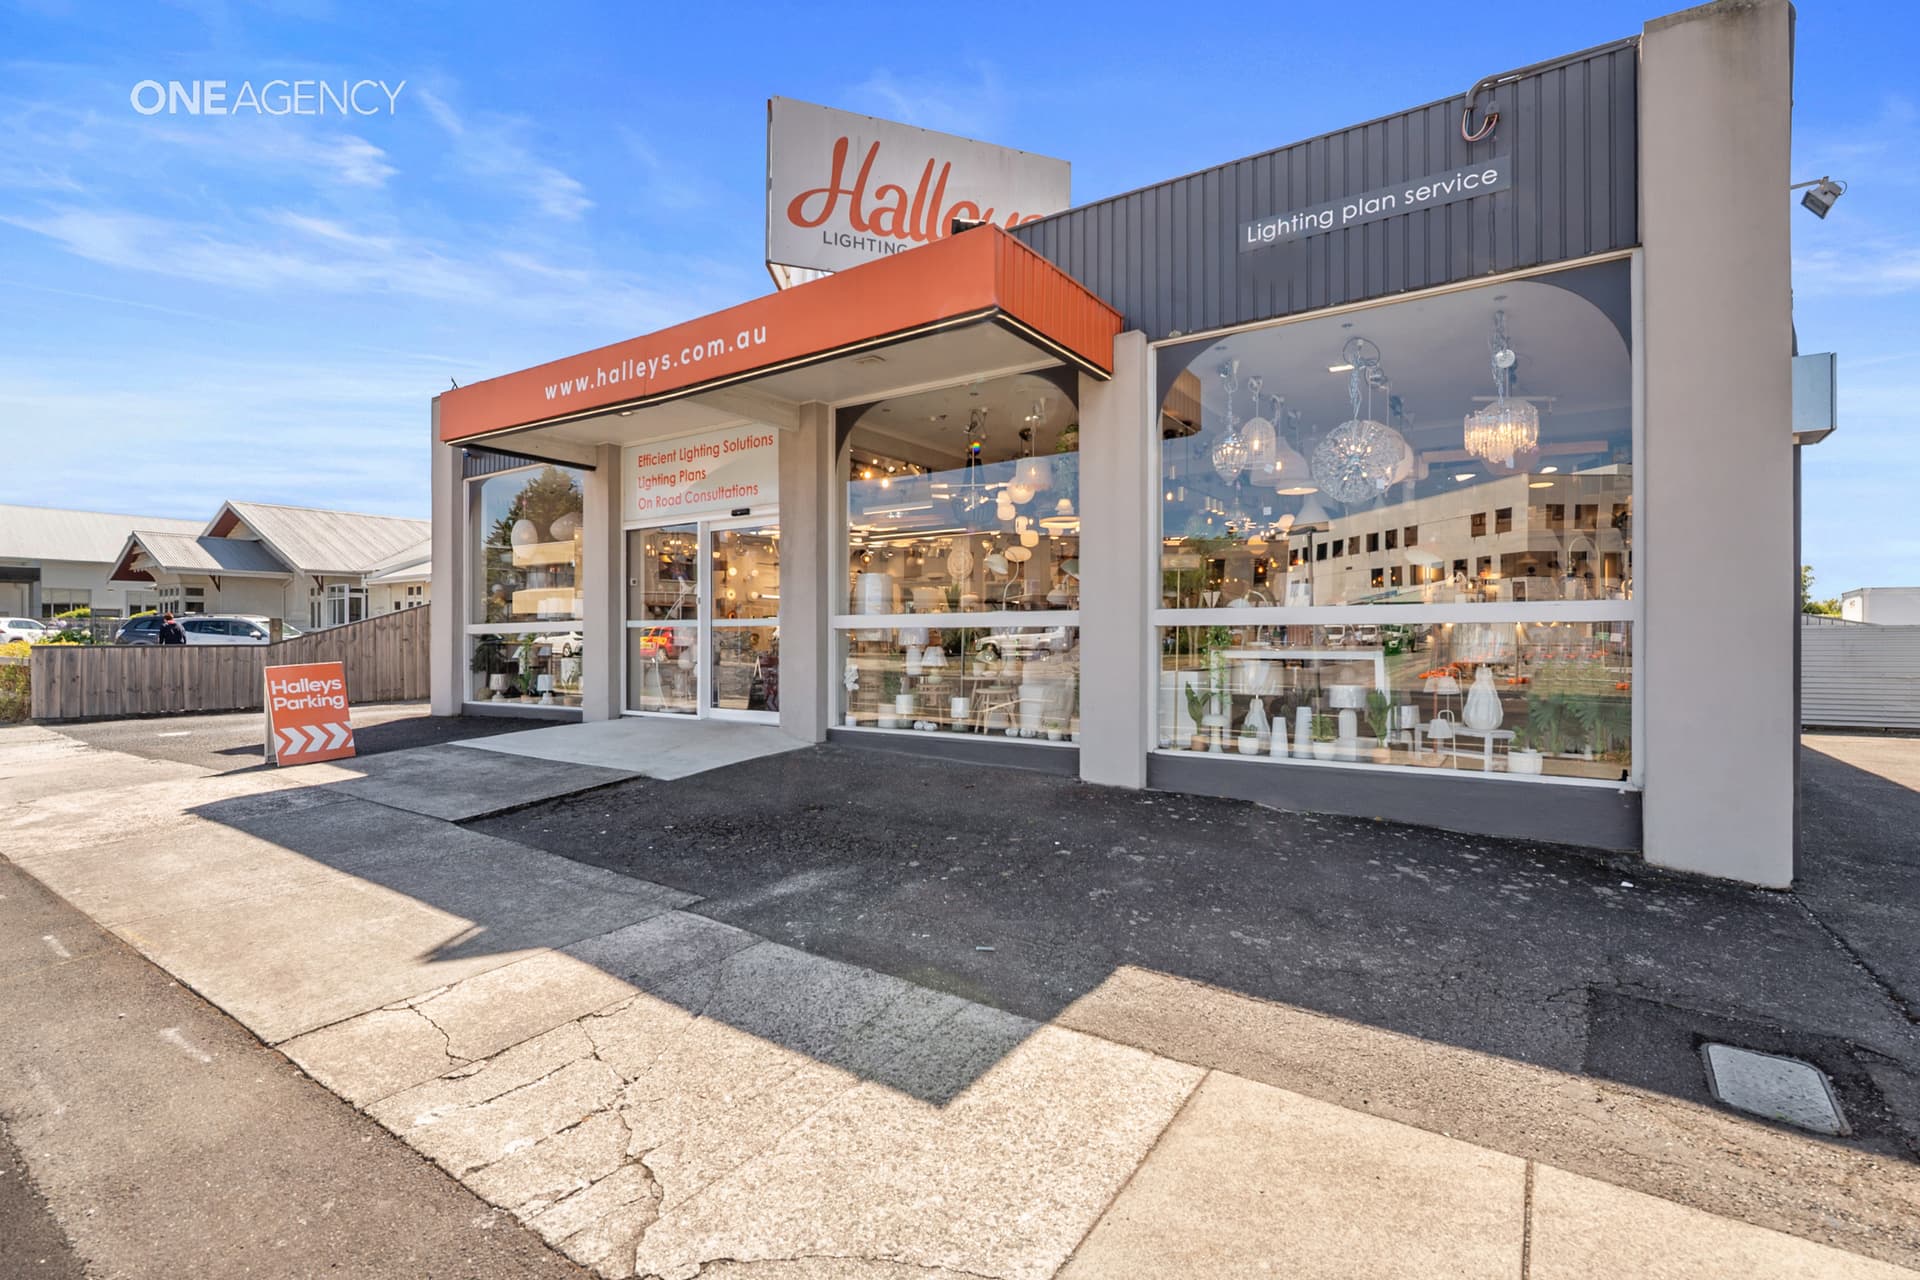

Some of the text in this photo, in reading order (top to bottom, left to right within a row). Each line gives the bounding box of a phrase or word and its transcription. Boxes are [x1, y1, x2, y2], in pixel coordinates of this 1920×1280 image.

[787, 136, 1044, 241] Halle
[1247, 168, 1498, 243] Lighting plan service
[544, 325, 767, 400] www.halleys.com.au
[638, 434, 774, 468] Efficient Lighting Solutions
[638, 468, 706, 491] Lighting Plans
[638, 483, 759, 510] On Road Consultations
[270, 678, 342, 695] Halleys
[273, 695, 344, 711] Parking
